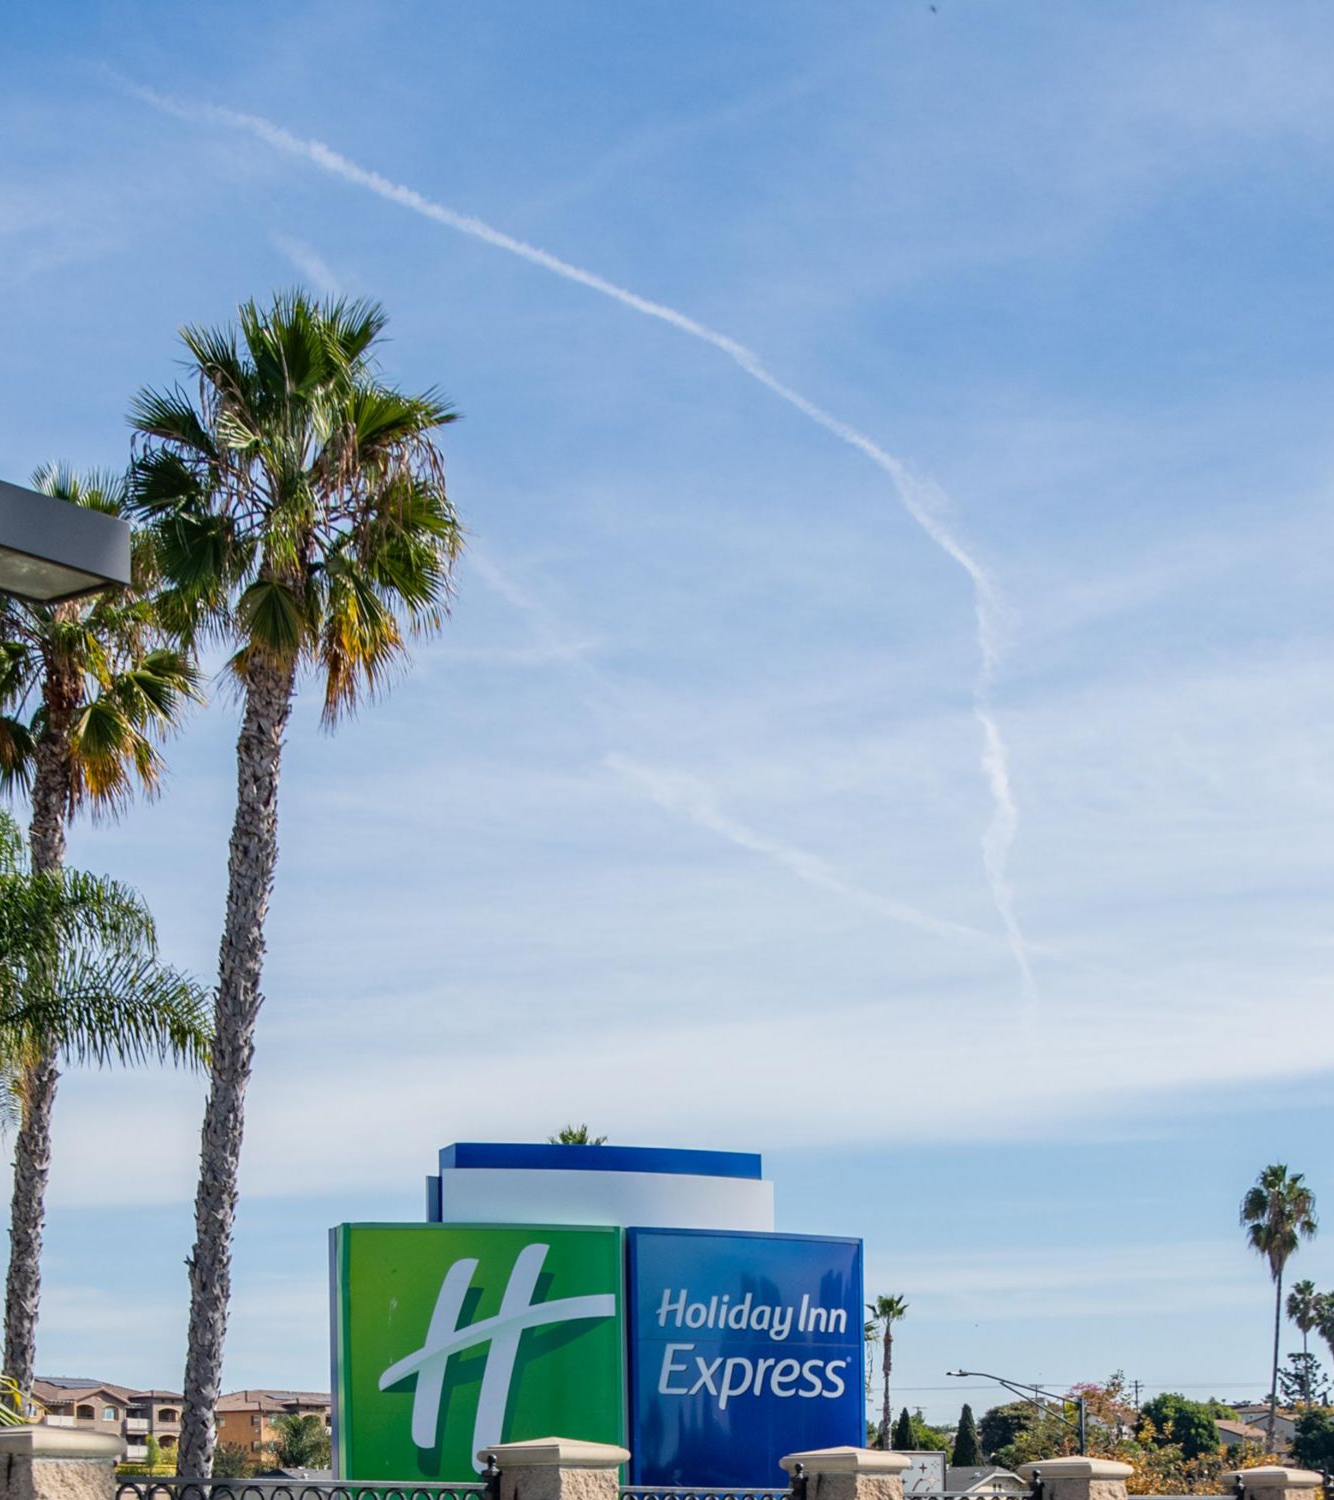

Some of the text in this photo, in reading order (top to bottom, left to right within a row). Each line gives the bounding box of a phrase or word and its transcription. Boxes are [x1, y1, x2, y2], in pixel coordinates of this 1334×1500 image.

[656, 1289, 847, 1341] Holiday Inn
[658, 1343, 847, 1410] Express
